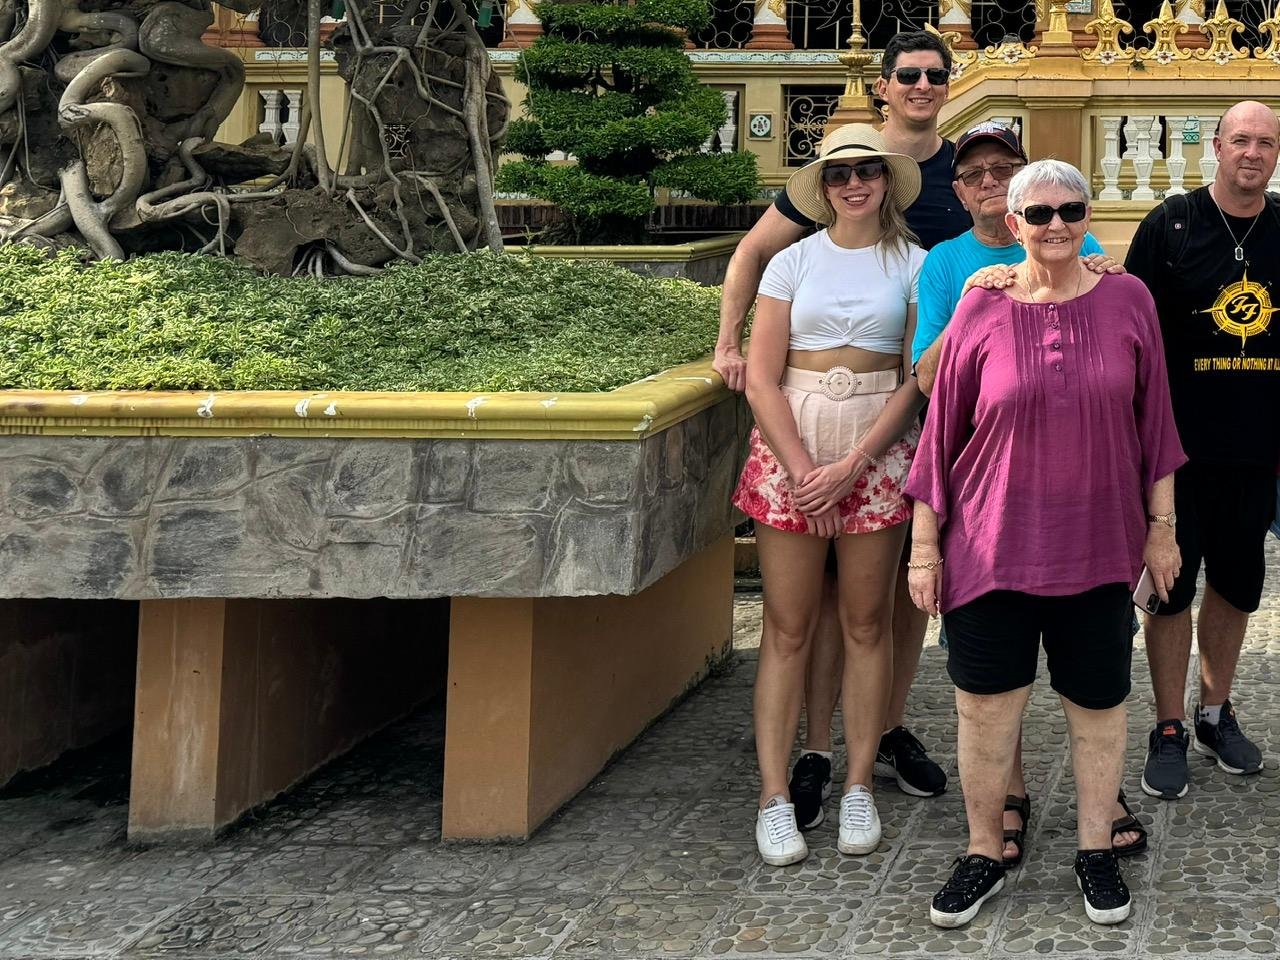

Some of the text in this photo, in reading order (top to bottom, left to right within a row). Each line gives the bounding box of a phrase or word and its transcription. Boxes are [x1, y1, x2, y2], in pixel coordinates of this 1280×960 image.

[1194, 358, 1212, 371] EVERY
[1212, 357, 1231, 370] THING
[1231, 357, 1241, 370] OR
[1241, 357, 1267, 370] NOTHING
